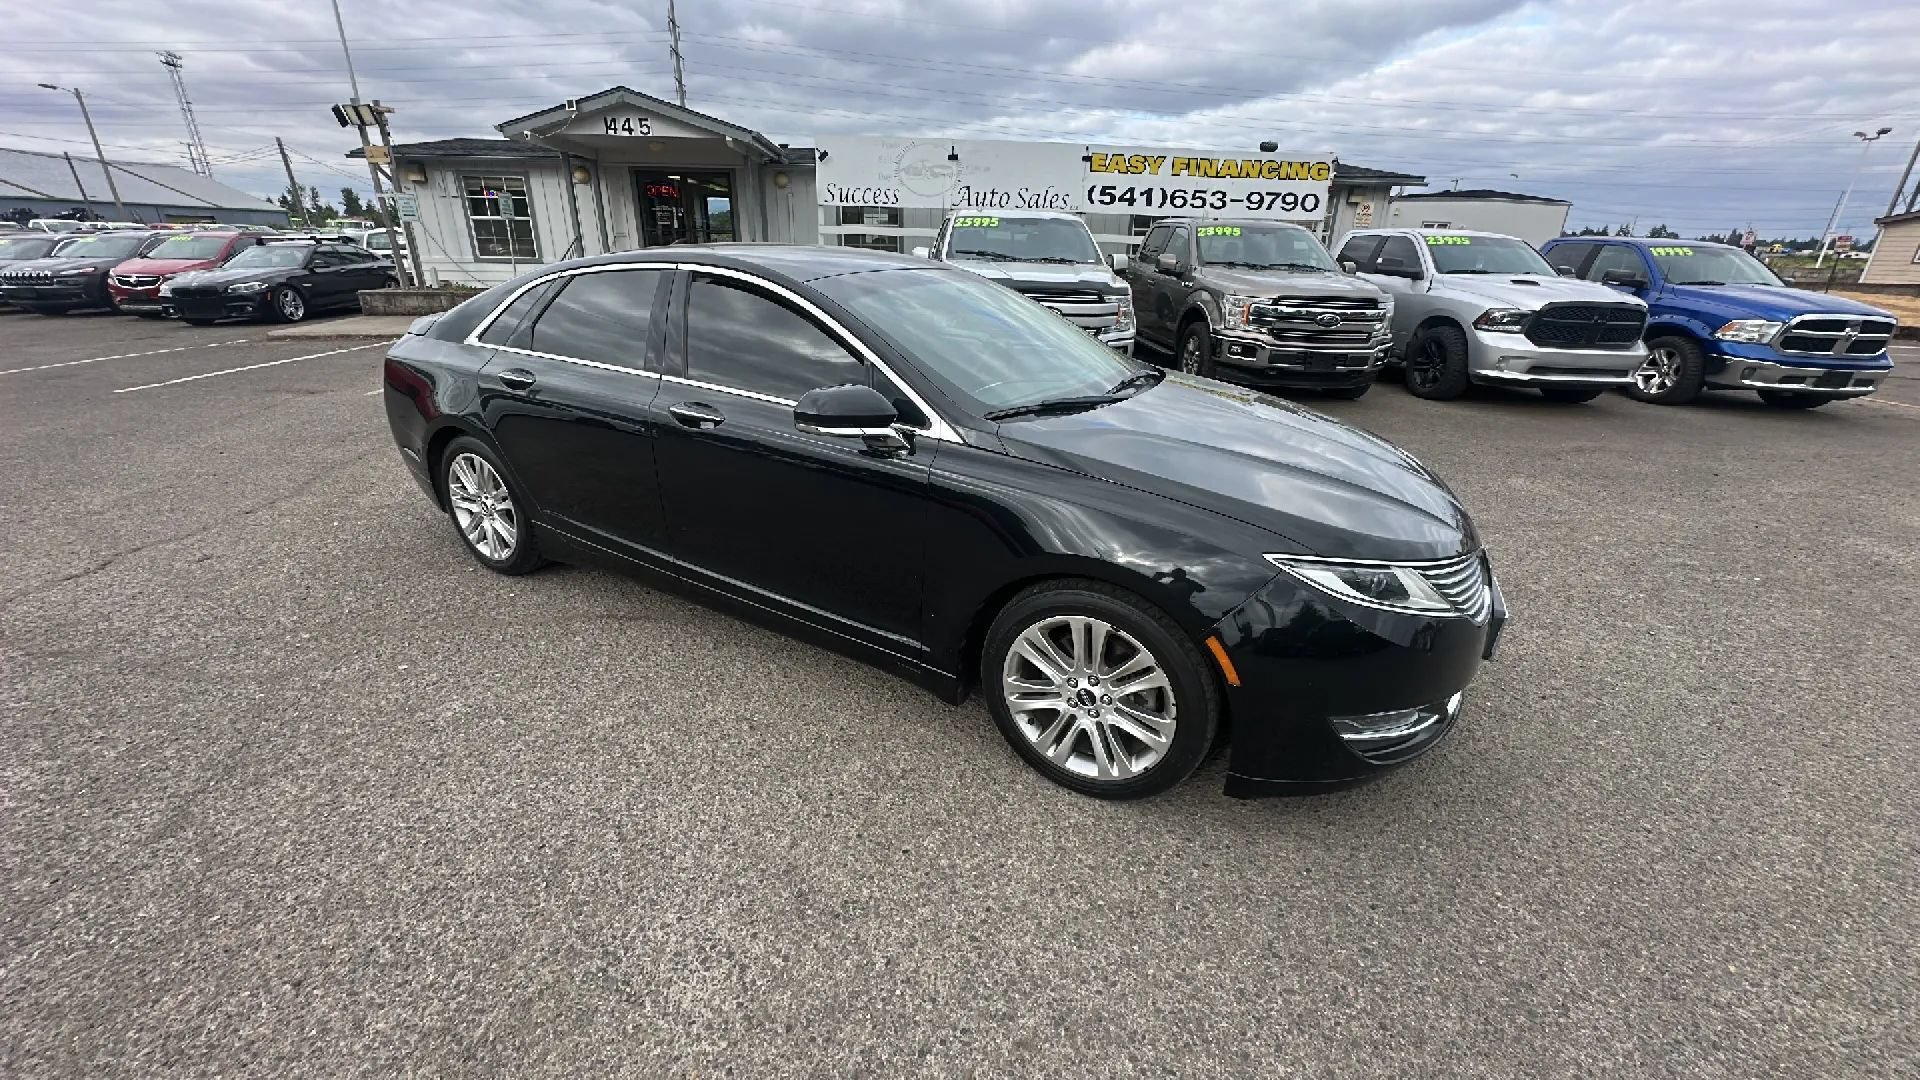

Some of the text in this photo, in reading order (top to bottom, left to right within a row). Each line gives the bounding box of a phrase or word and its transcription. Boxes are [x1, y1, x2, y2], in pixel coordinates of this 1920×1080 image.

[1089, 152, 1331, 181] EASY FINANCING
[646, 184, 677, 199] OPEN
[823, 182, 1070, 210] Success Auto Sales
[1087, 184, 1320, 213] (541)653-9790
[954, 217, 999, 227] 25995
[1426, 236, 1471, 245] 23995
